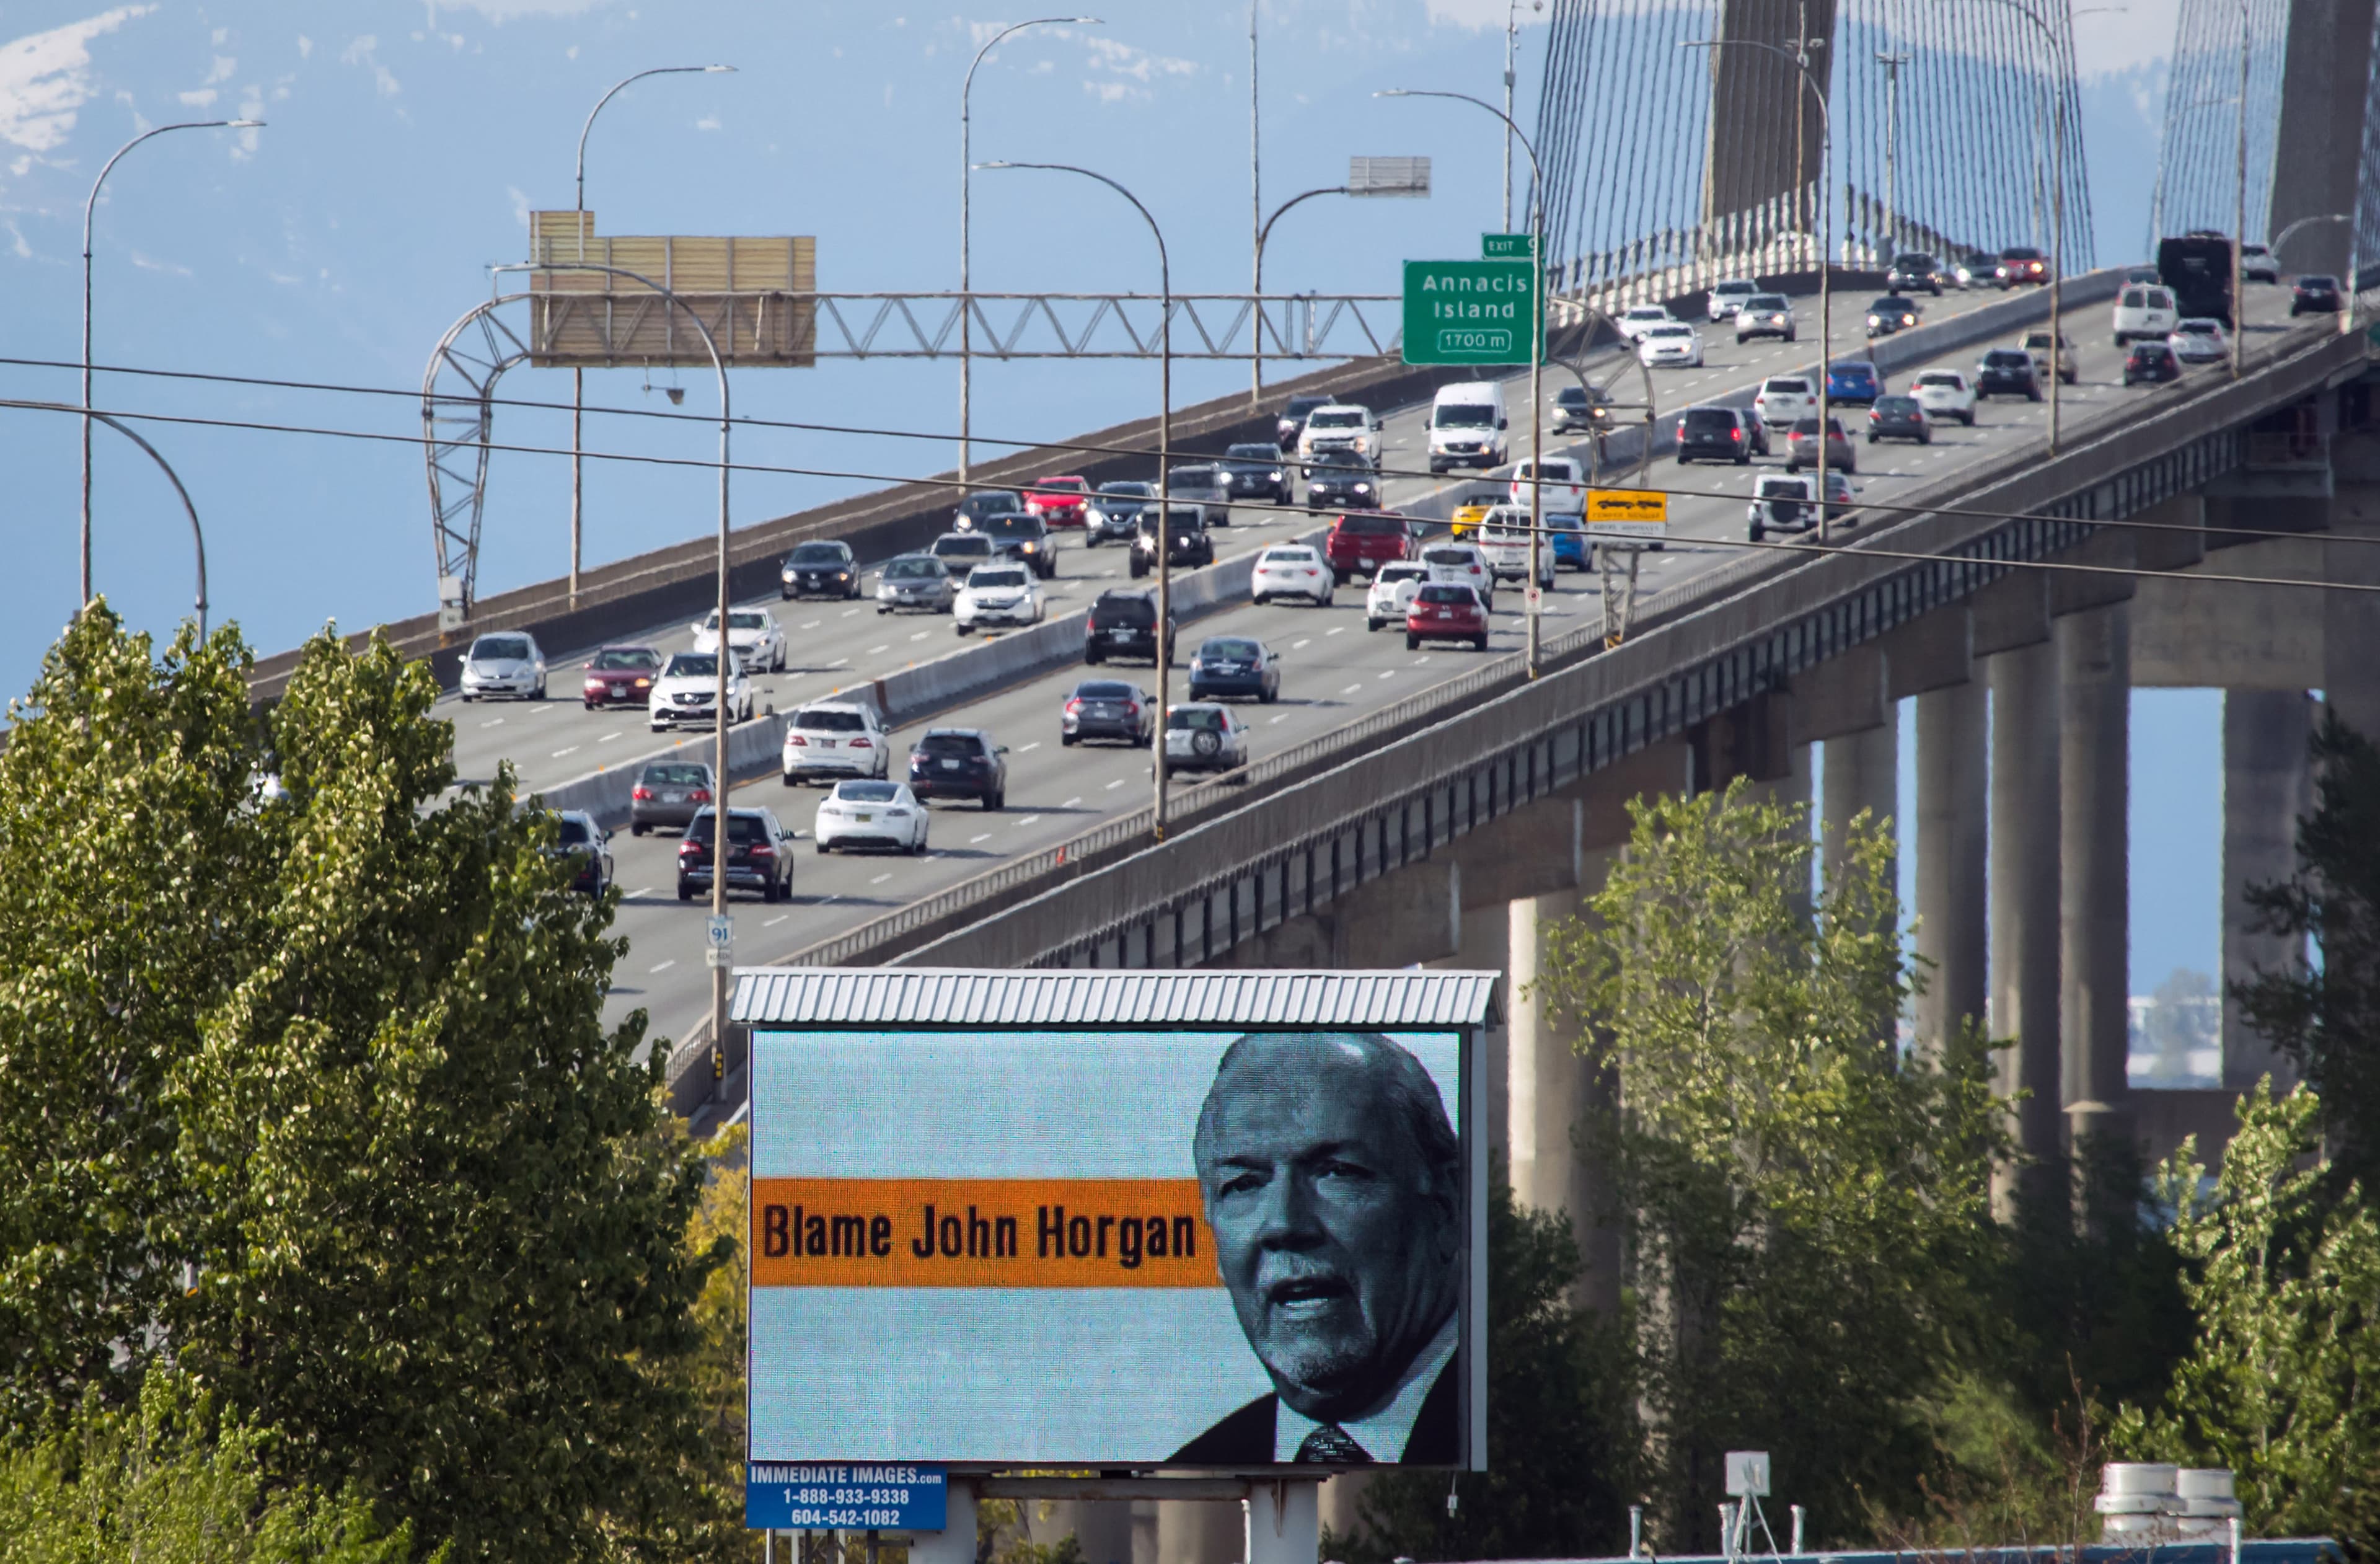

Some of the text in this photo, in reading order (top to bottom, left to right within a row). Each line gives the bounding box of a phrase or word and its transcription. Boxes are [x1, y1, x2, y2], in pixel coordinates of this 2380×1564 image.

[1488, 241, 1514, 251] EXIT
[1422, 274, 1528, 293] Annacis
[1434, 301, 1514, 318] Island
[1445, 334, 1505, 347] 1700 m
[712, 927, 728, 941] 91
[763, 1203, 1196, 1268] Blame John Horgan
[751, 1465, 942, 1484] IMMEDIATE IMAGES.com
[783, 1488, 909, 1504] 1-888-933-9338
[791, 1509, 900, 1526] 604-542-1082
